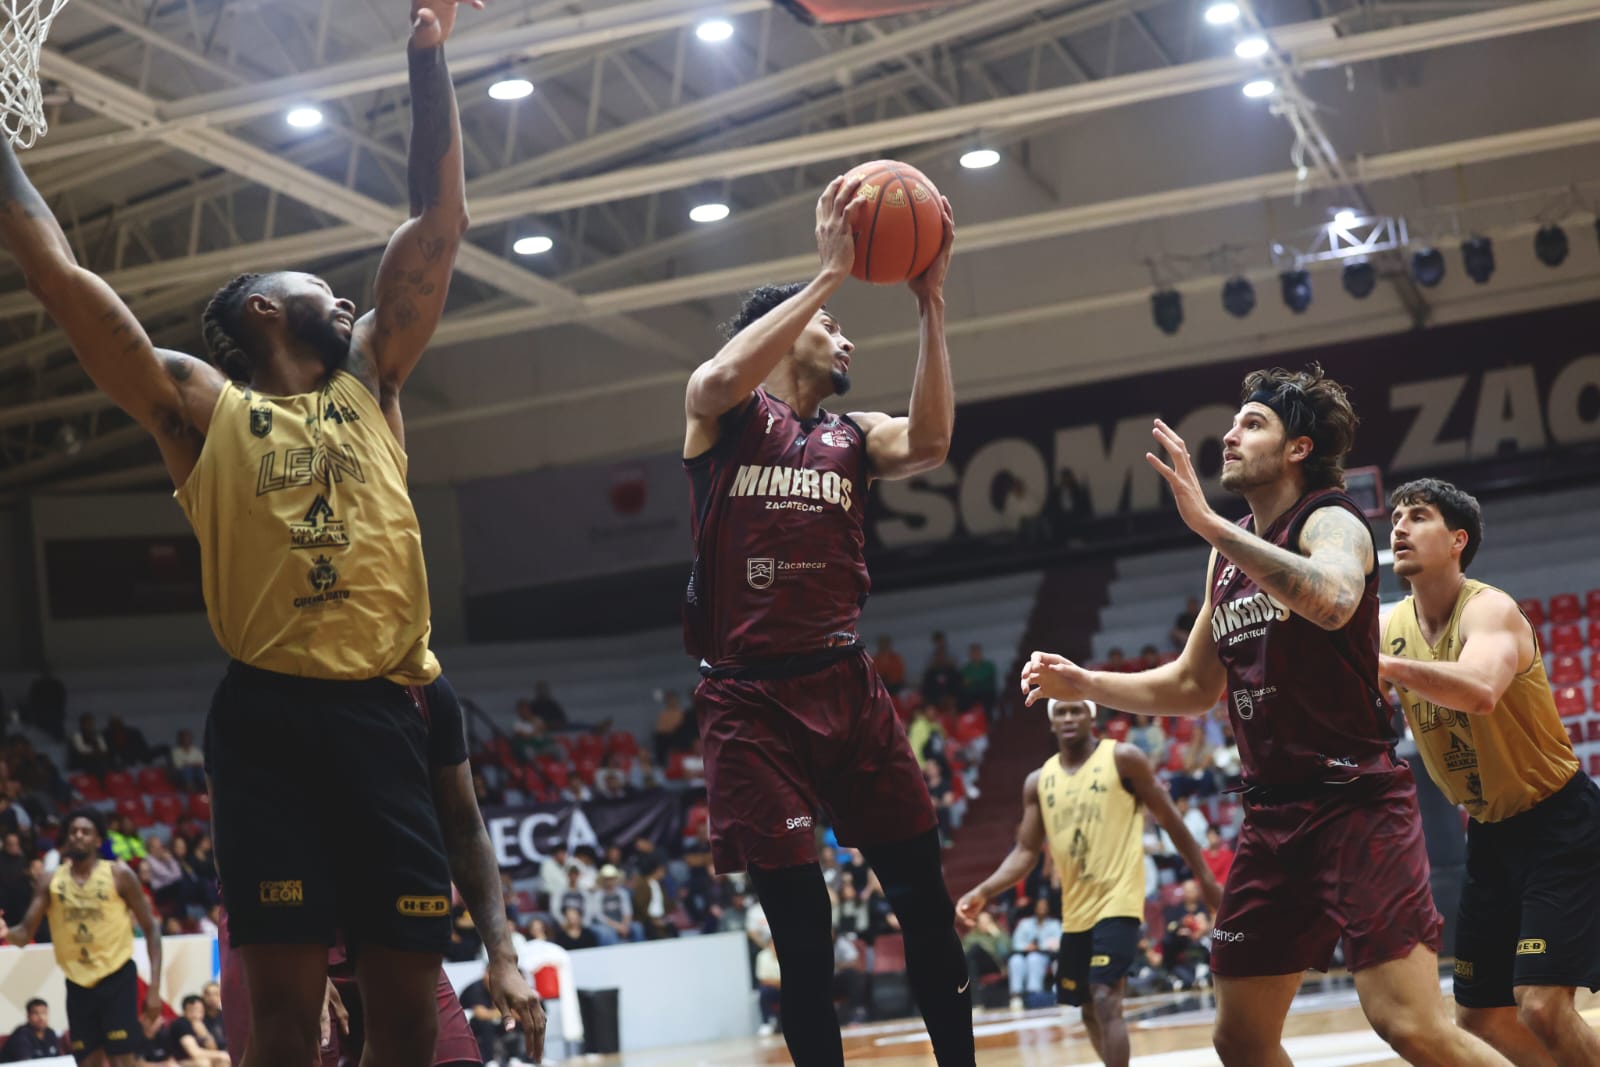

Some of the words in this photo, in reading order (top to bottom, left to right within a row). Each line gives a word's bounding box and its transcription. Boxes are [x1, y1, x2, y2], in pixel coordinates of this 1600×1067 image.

[729, 465, 852, 512] MINEROS
[765, 501, 823, 513] ZACATECAS
[291, 533, 348, 545] MEXICANA
[777, 561, 827, 569] Zacatecas
[1228, 627, 1267, 646] ZACATECA
[1213, 928, 1245, 942] sense
